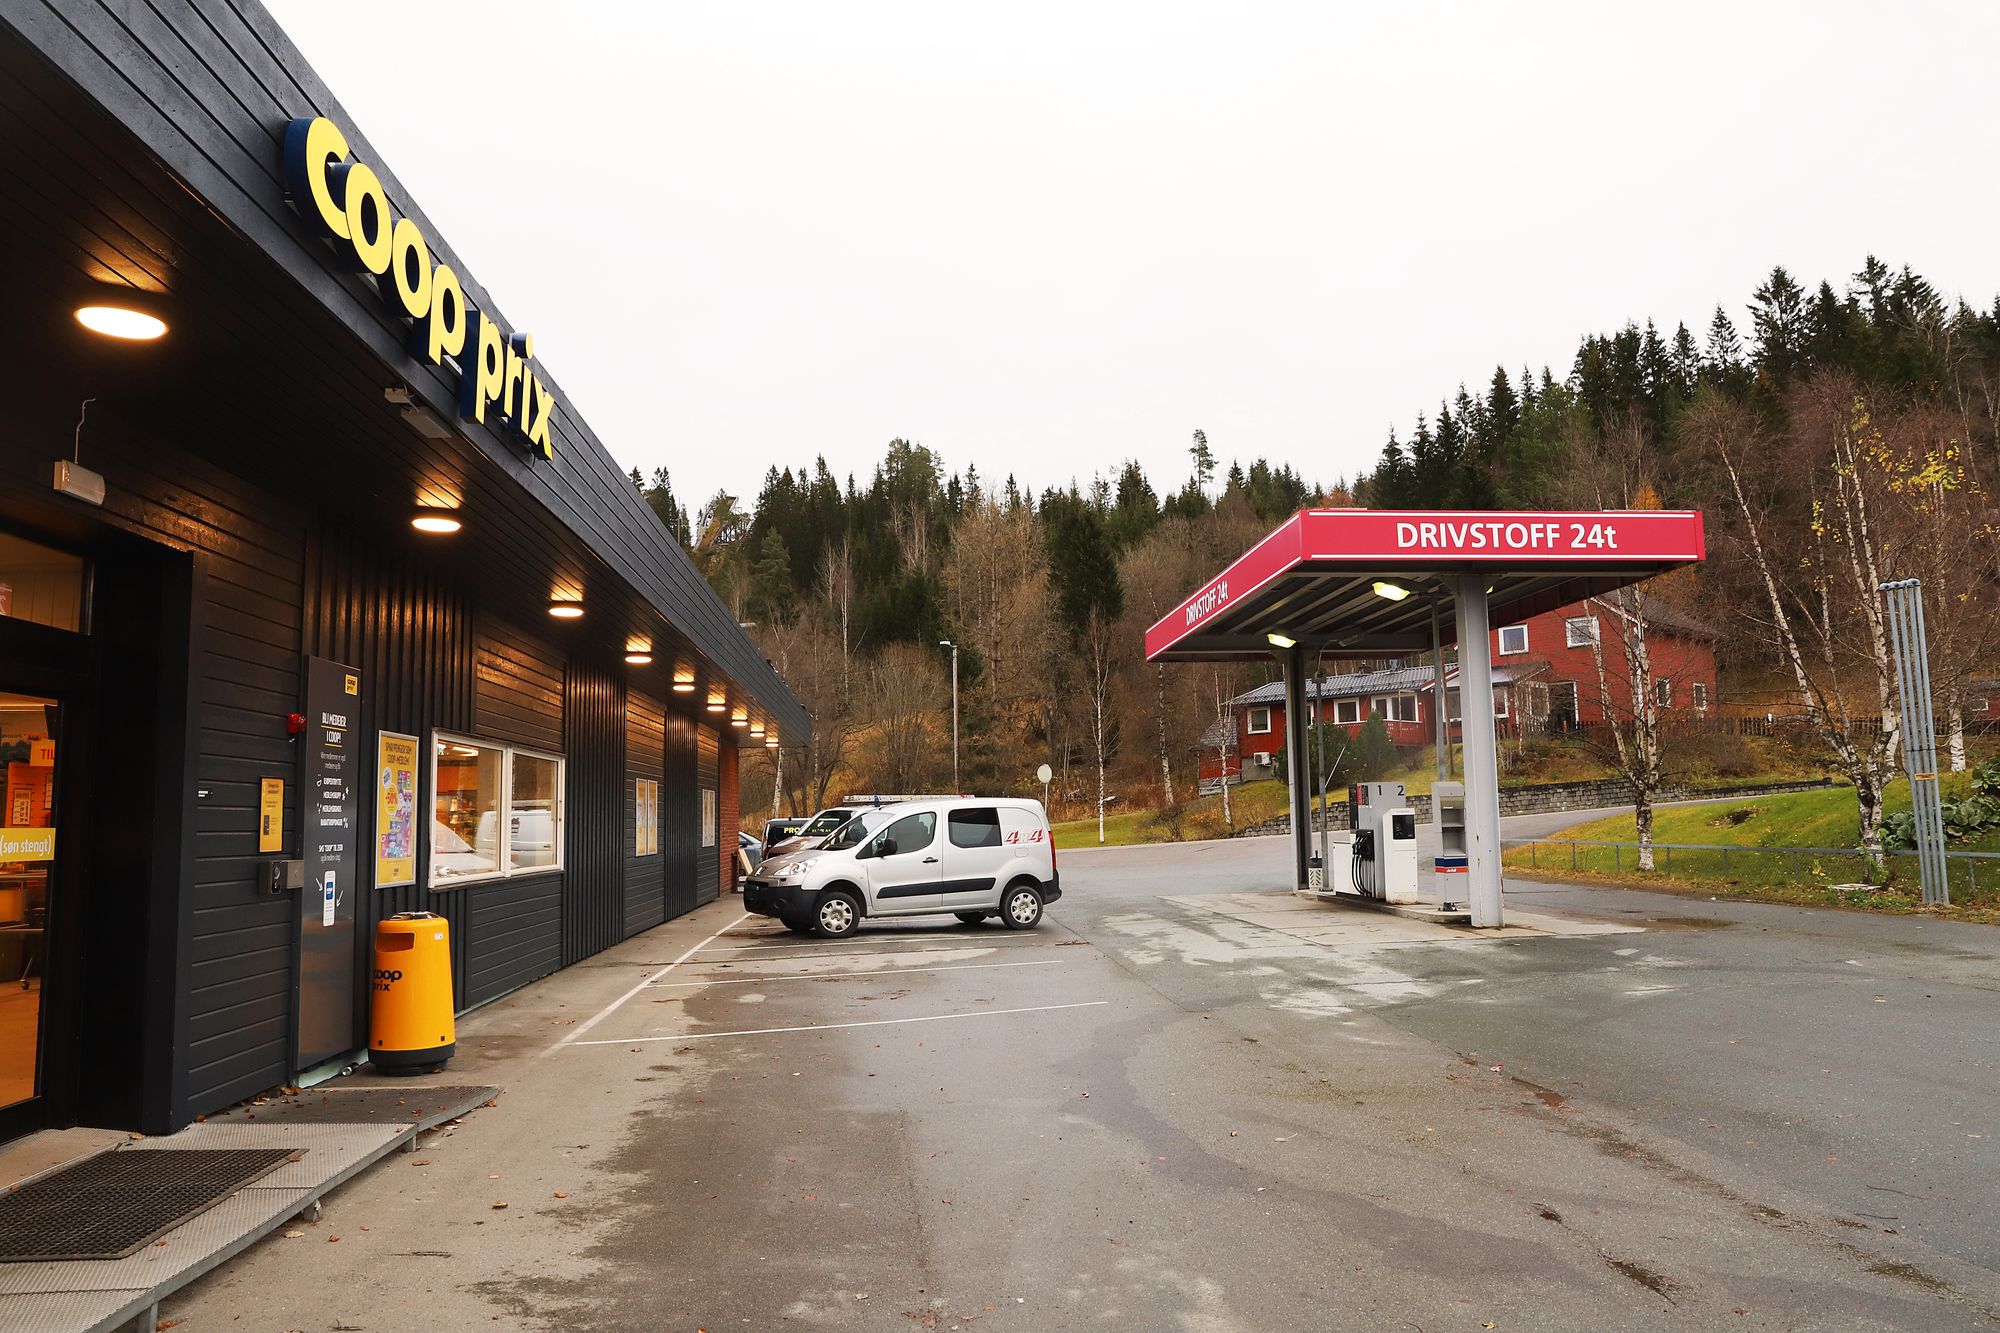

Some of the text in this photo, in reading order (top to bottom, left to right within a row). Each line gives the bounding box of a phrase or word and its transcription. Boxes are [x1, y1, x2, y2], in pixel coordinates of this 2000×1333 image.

[304, 116, 555, 462] coop prix
[1396, 522, 1618, 549] DRIVSTOFF 24t
[1185, 580, 1229, 627] DRIVSTOFF 24t
[1377, 785, 1382, 796] 1
[1397, 785, 1405, 796] 2
[20, 834, 52, 857] stengt)
